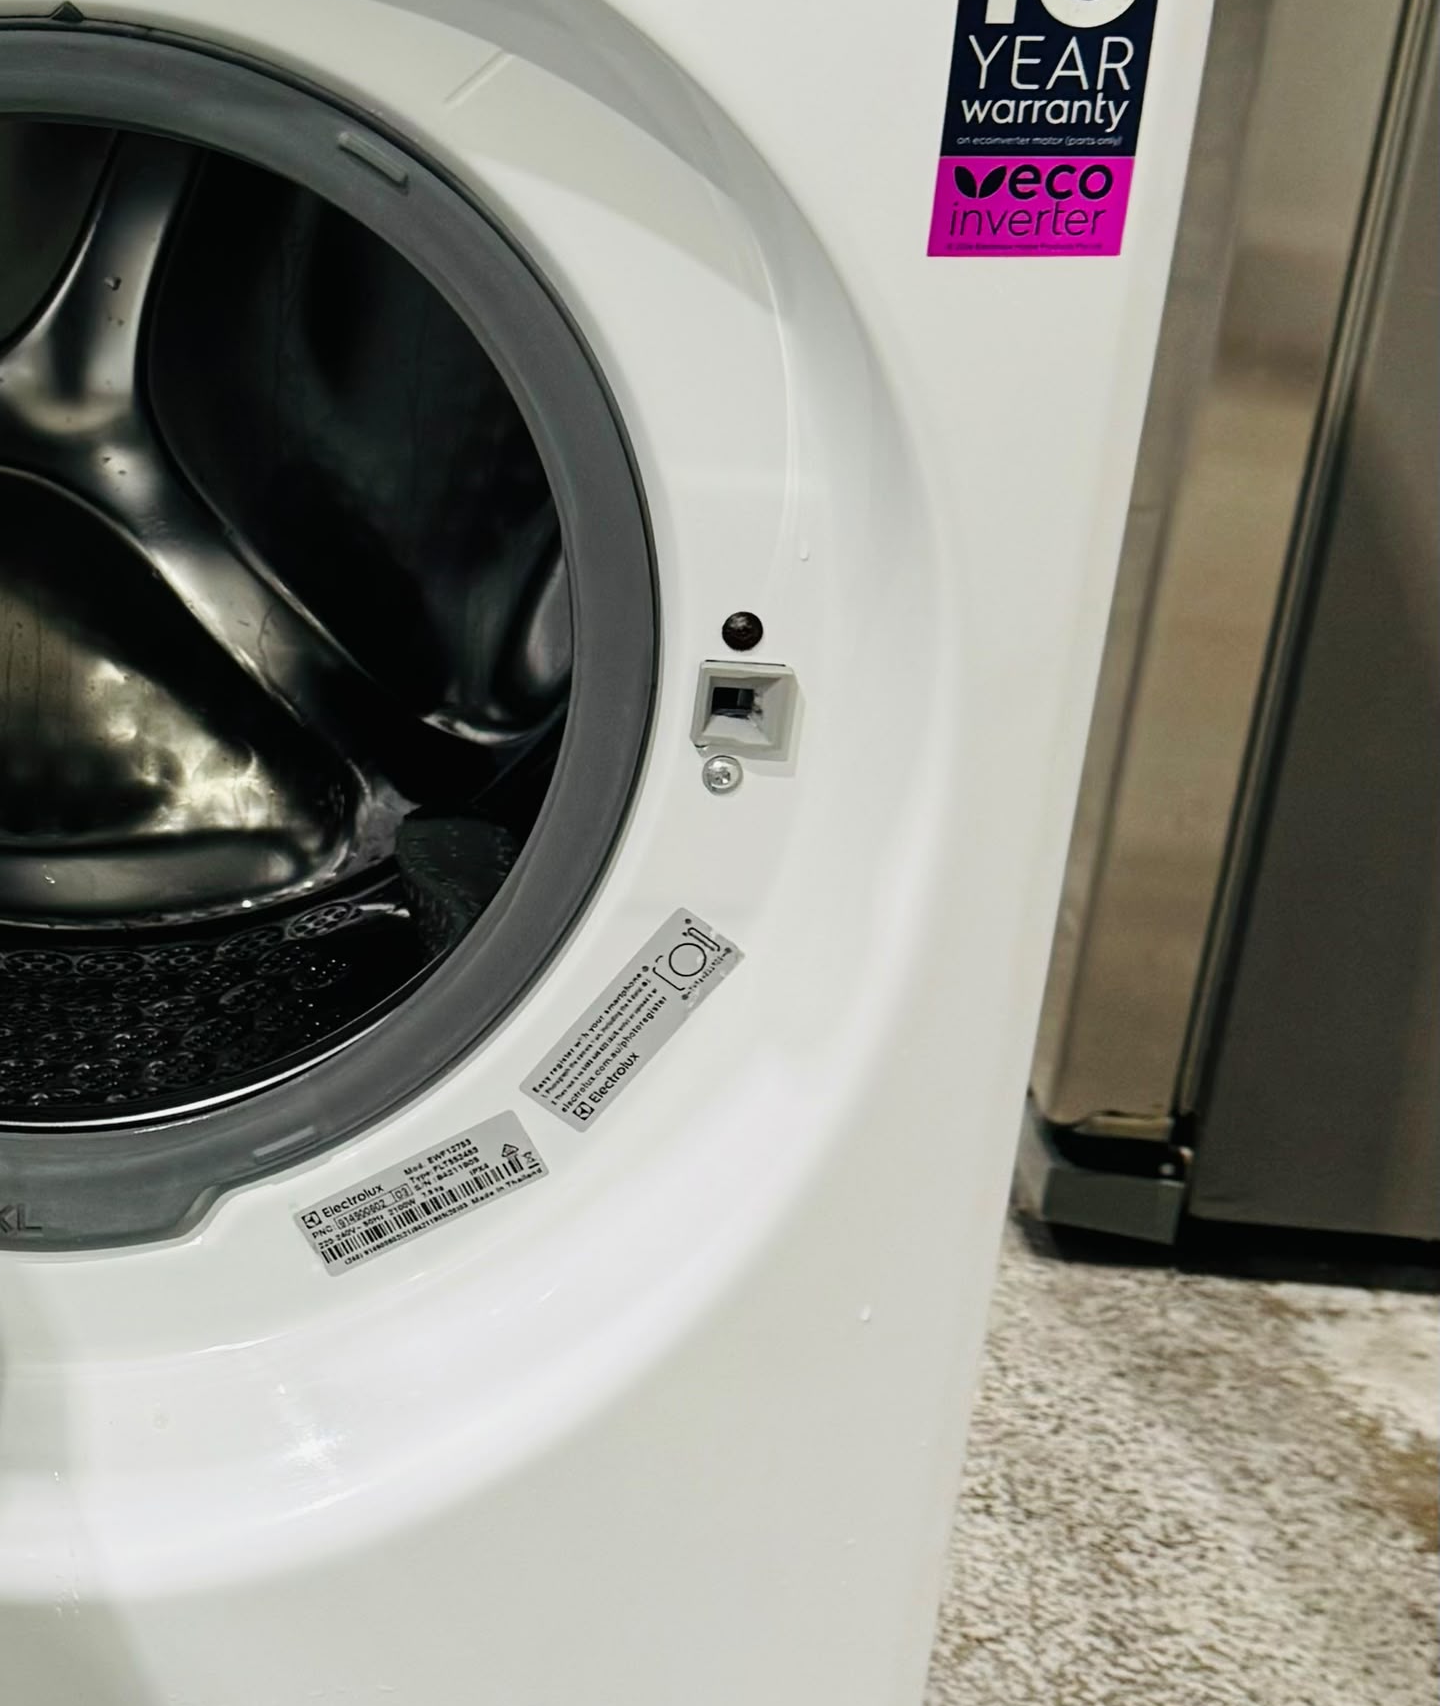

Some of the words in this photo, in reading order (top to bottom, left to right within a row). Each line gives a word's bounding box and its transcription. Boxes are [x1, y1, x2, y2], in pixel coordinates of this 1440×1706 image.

[968, 34, 1135, 91] YEAR
[961, 94, 1130, 133] warranty
[1008, 164, 1113, 200] eco
[949, 201, 1107, 237] inverter
[530, 1074, 552, 1094] Easy
[547, 1046, 577, 1076] register
[587, 1014, 606, 1033] your
[602, 971, 644, 1015] smartphone
[587, 1049, 641, 1104] Electrolux
[320, 1180, 385, 1219] Electrolux
[310, 1224, 334, 1239] PNC
